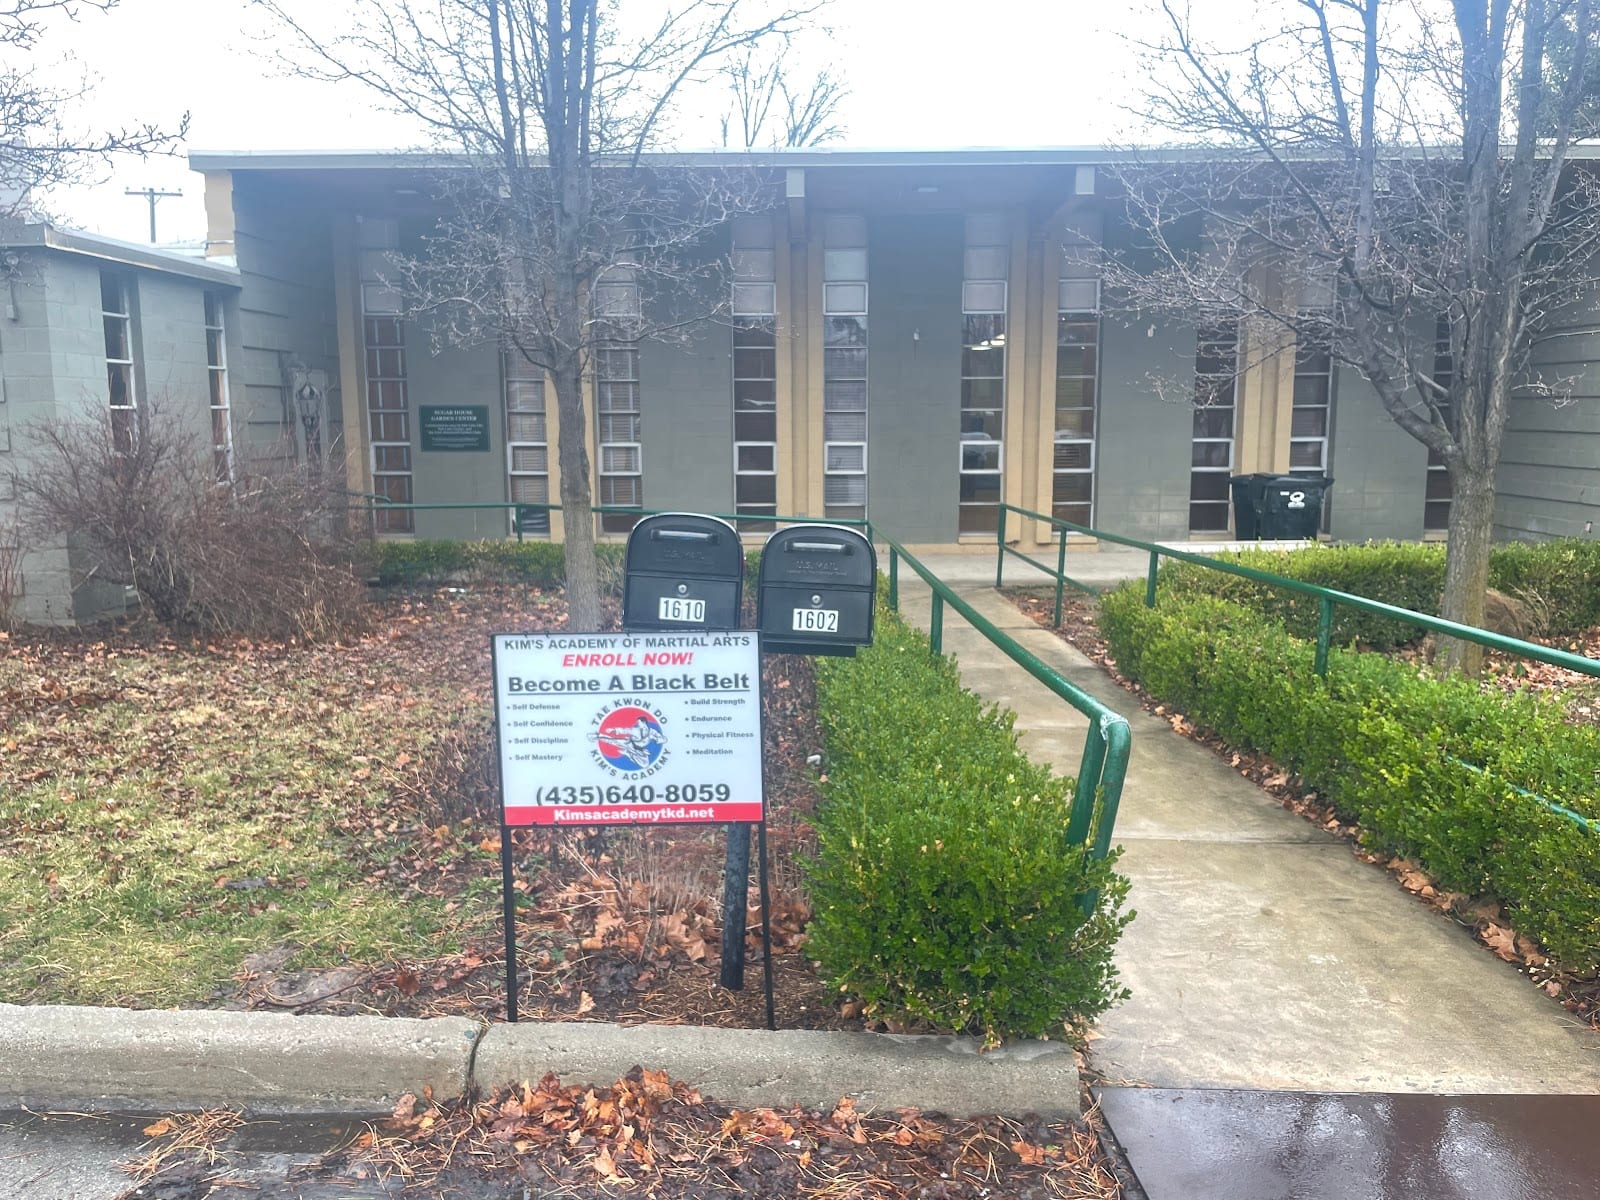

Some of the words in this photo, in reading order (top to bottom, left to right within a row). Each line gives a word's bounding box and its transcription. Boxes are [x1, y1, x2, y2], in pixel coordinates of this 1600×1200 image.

[662, 600, 704, 620] 1610
[796, 610, 837, 631] 1602
[504, 639, 544, 650] KIM'S
[549, 638, 618, 649] ACADEMY
[622, 638, 641, 648] OF
[645, 637, 709, 648] MARTIAL
[713, 636, 750, 647] ARTS
[562, 654, 637, 667] ENROLL
[642, 652, 694, 666] NOW!
[508, 676, 600, 692] Become
[608, 675, 625, 691] A
[632, 674, 696, 690] Black
[704, 673, 750, 689] Belt
[529, 703, 561, 711] Defense
[712, 698, 746, 706] Strength
[591, 705, 611, 727] TAE
[613, 697, 651, 710] KWON
[653, 709, 668, 725] DO
[530, 720, 574, 728] Confidence
[531, 737, 569, 745] Discipline
[532, 754, 564, 762] Mastery
[590, 748, 618, 777] KIM'S
[622, 748, 672, 781] ACADEMY
[536, 783, 731, 806] (435)640-8059
[554, 807, 715, 821] Kimsacademytkd.net
